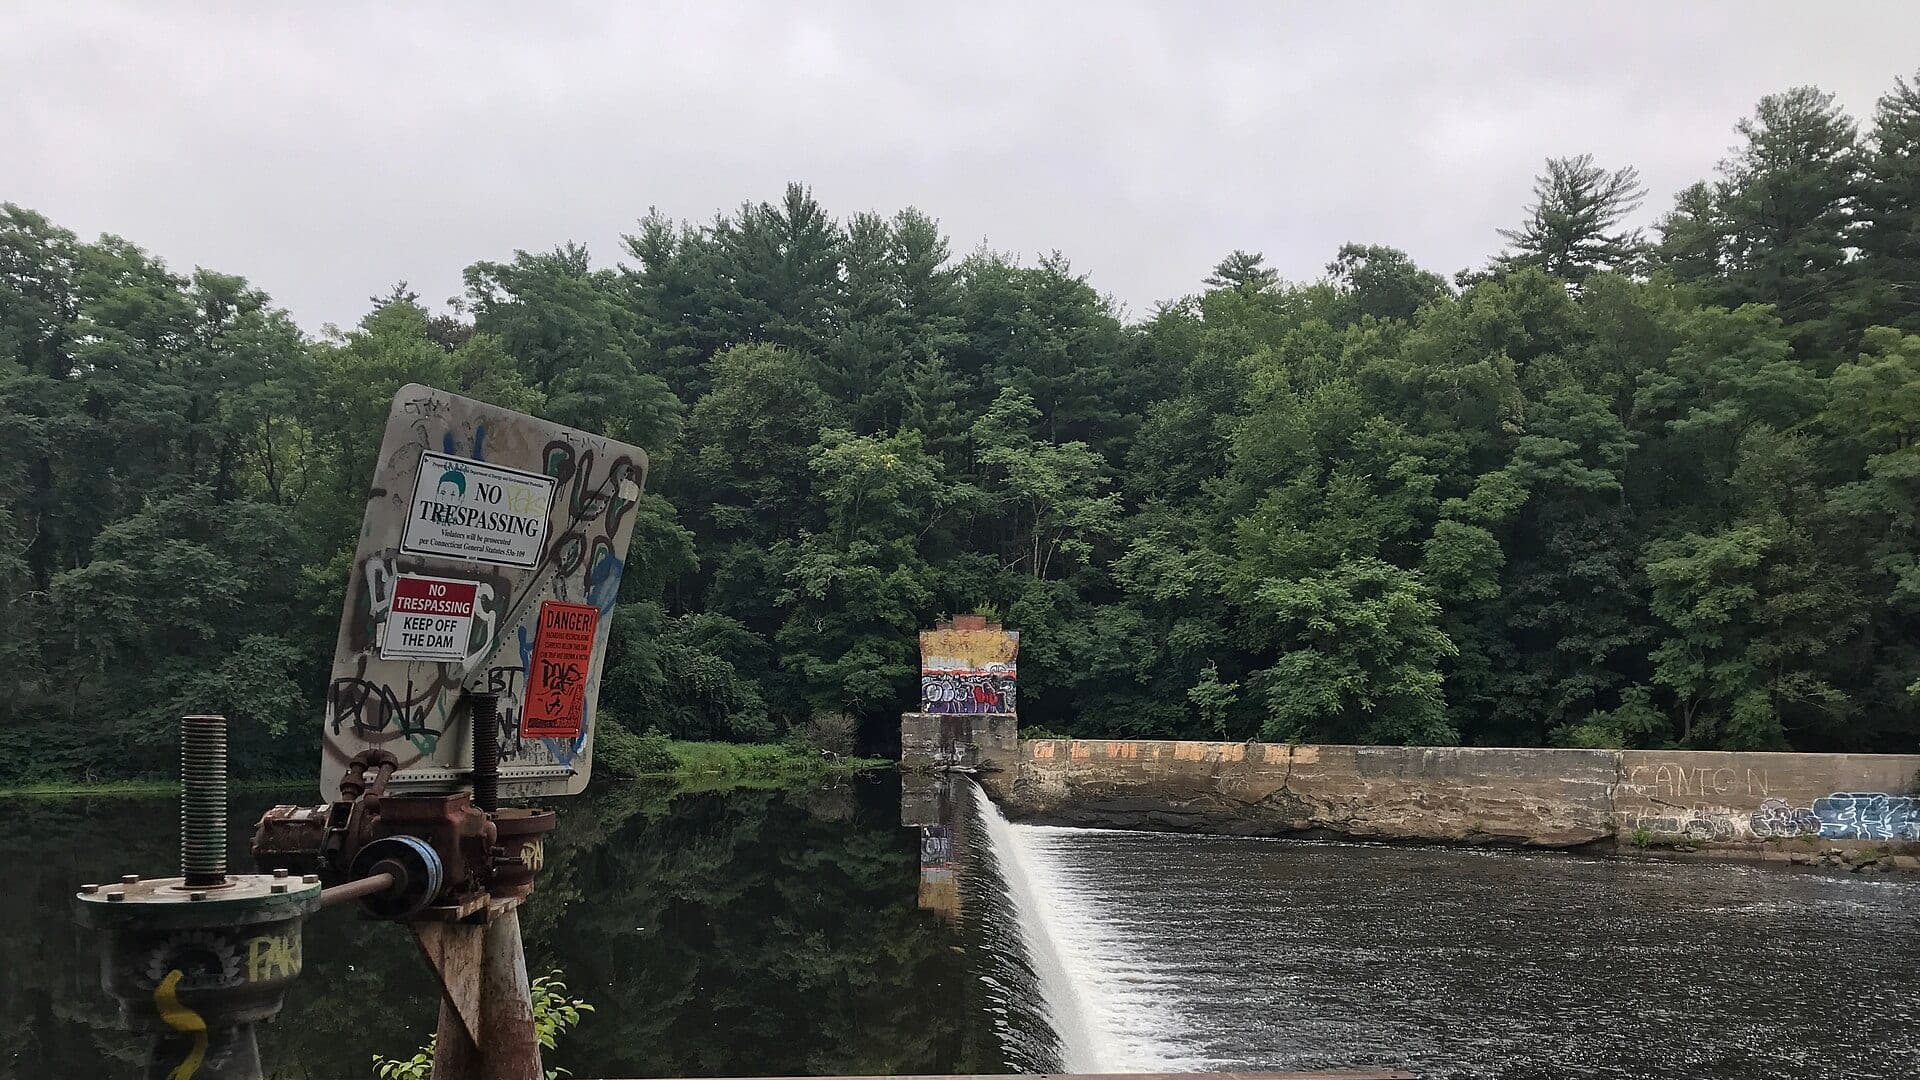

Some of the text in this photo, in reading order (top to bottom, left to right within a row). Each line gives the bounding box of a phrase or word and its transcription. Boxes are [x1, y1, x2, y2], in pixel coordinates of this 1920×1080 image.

[474, 482, 503, 505] NO
[419, 500, 539, 538] TRESPASSING
[418, 538, 430, 546] per
[430, 537, 463, 549] Connecticut
[463, 543, 485, 552] General
[485, 546, 505, 554] Statutes
[441, 529, 465, 539] Violators
[484, 536, 512, 546] prosecuted
[428, 584, 446, 597] NO
[397, 597, 470, 614] TRESPASSING
[403, 617, 458, 632] KEEP OFF
[546, 610, 593, 632] DANGER!
[402, 633, 454, 648] THE DAM
[1630, 762, 1769, 797] CANTON
